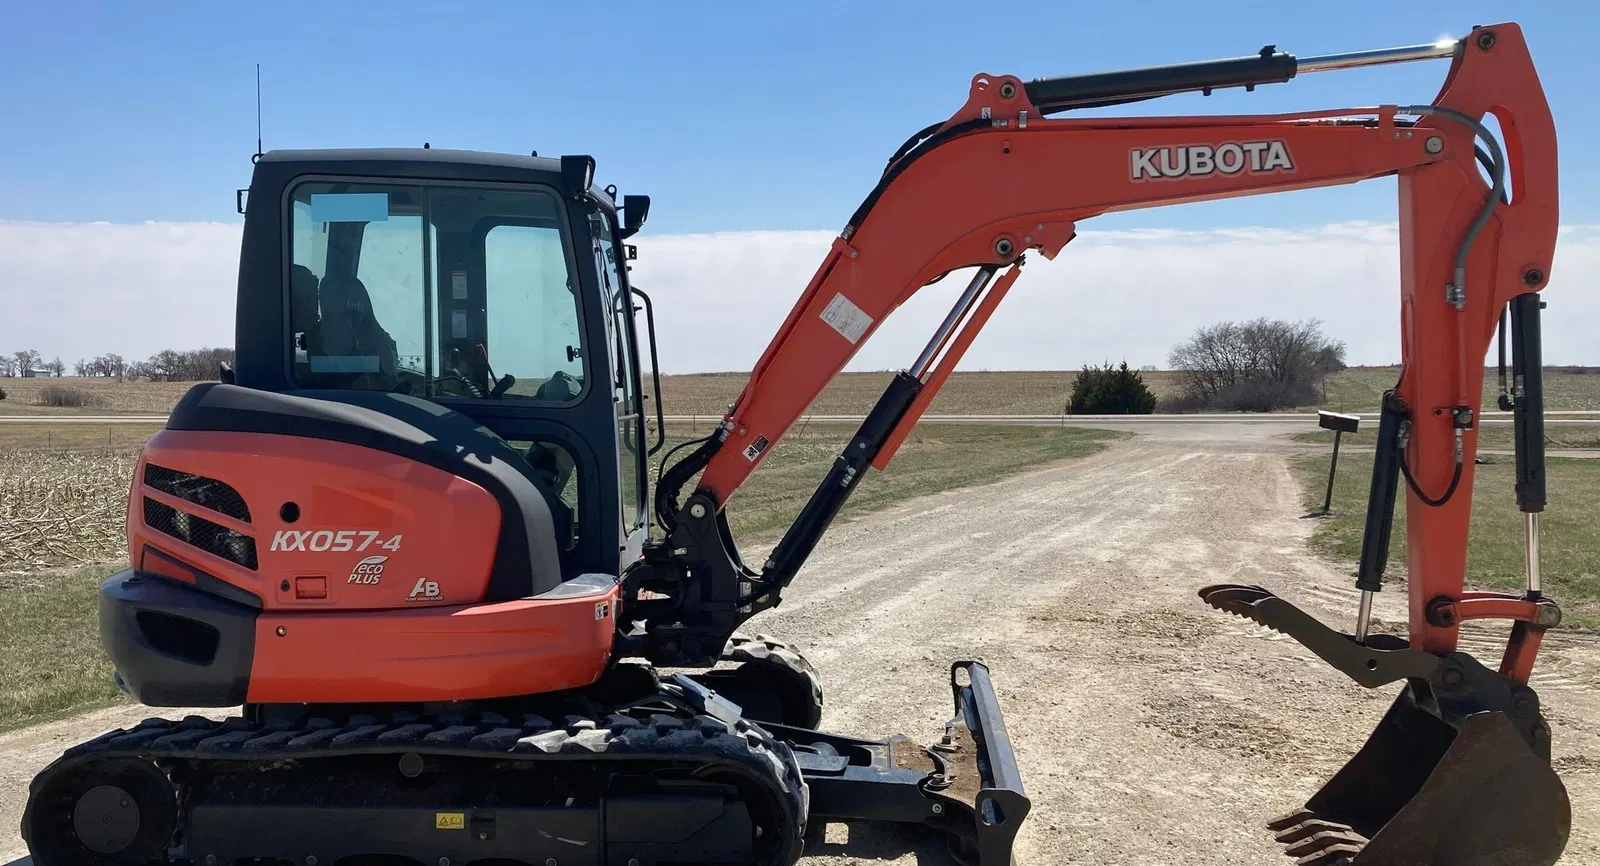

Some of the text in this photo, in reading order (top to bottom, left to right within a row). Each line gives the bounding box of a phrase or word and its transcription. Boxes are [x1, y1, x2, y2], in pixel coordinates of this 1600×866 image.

[1131, 141, 1293, 179] KUBOTA
[270, 530, 402, 552] KX057-4
[358, 564, 384, 574] eco
[347, 573, 381, 585] PLUS
